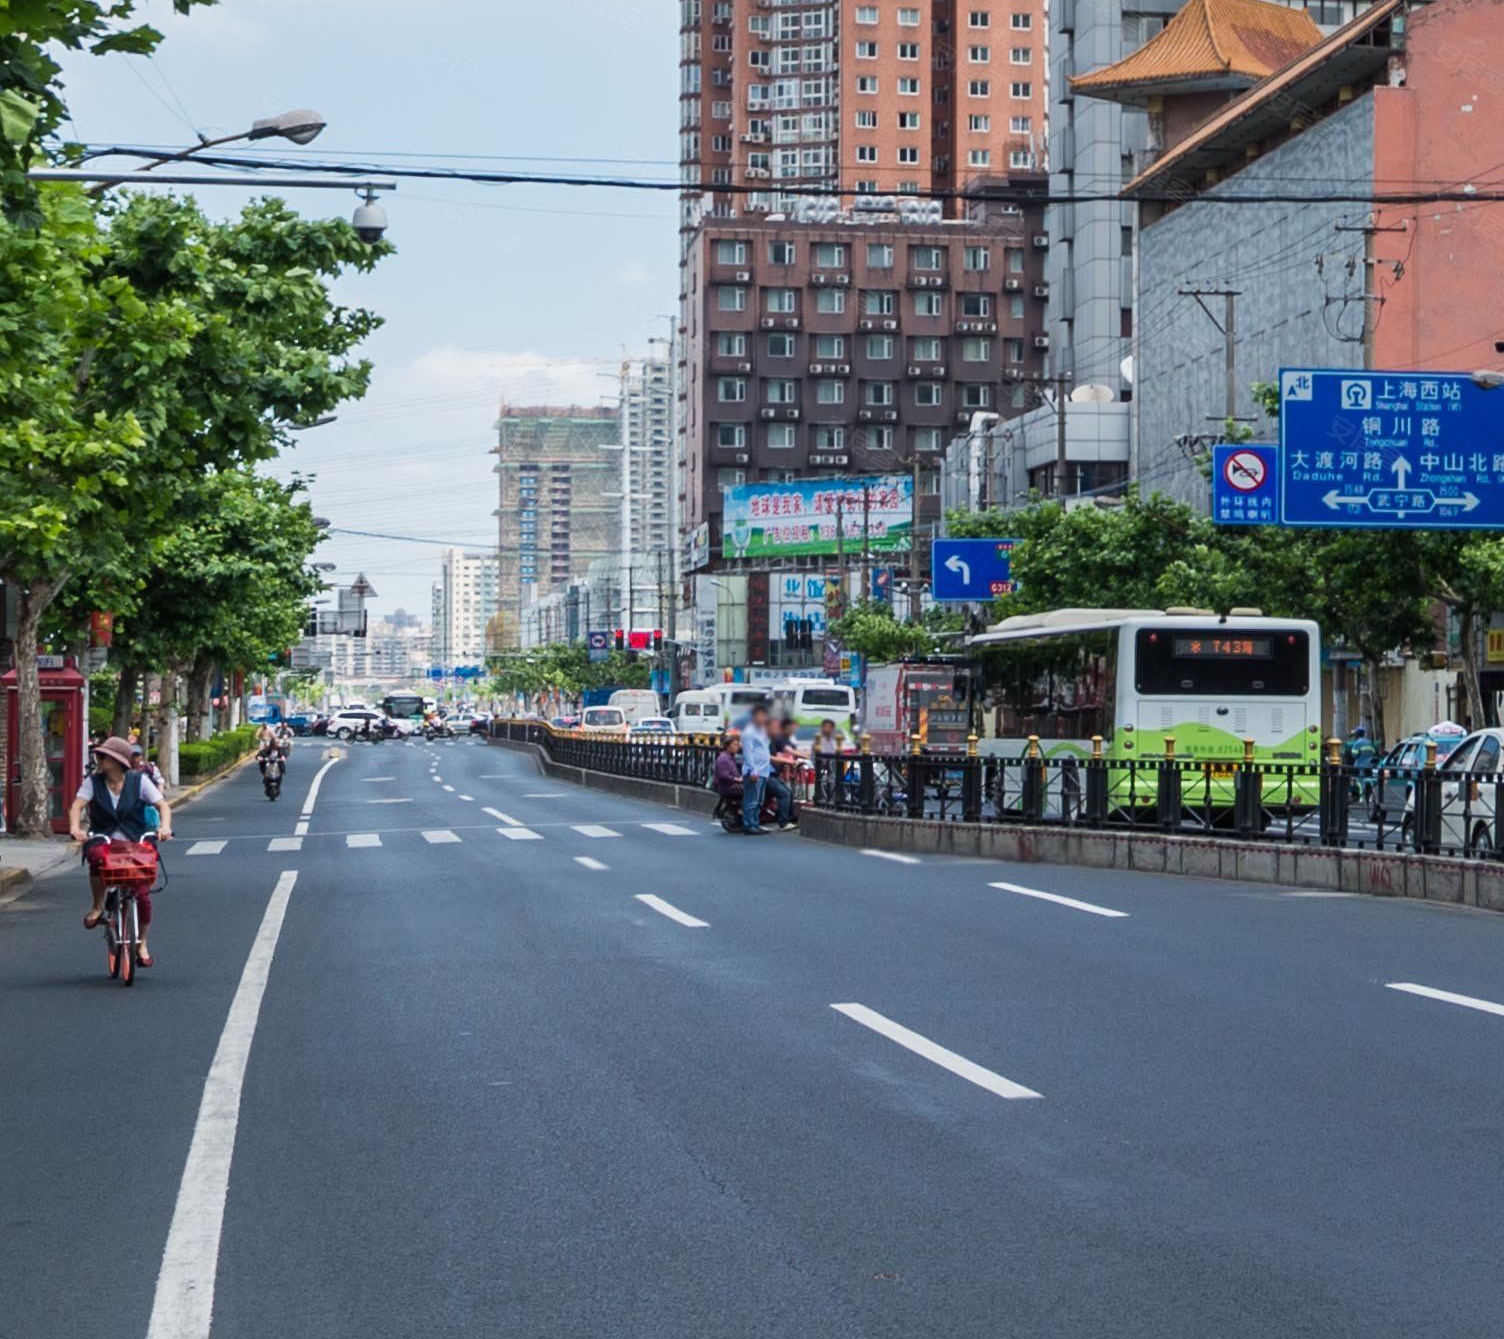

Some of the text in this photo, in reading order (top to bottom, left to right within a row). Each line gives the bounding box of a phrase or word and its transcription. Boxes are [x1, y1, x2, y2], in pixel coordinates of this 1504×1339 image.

[1296, 376, 1309, 389] 北
[1378, 381, 1461, 400] 上海西站
[1362, 416, 1440, 436] 铜川路
[1291, 451, 1382, 470] 大渡河路
[1293, 472, 1384, 481] Daduhe Rd.
[1377, 493, 1425, 508] 武宁路
